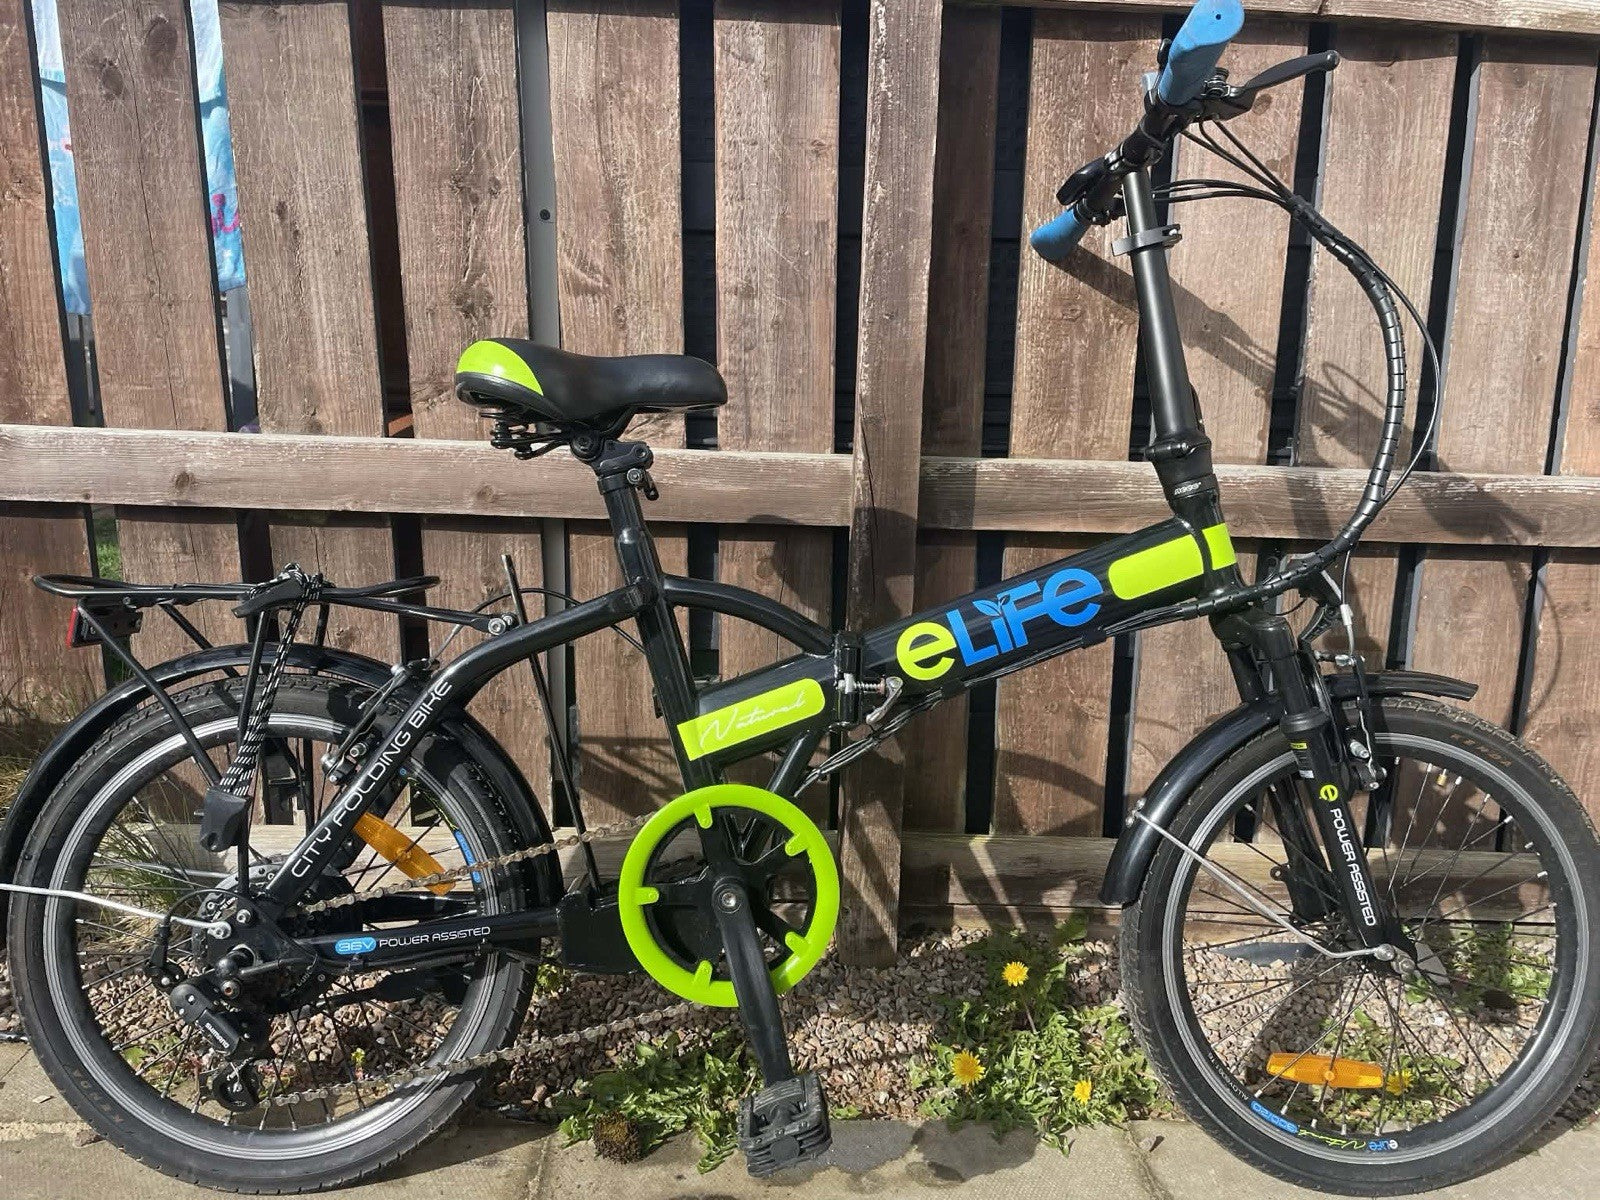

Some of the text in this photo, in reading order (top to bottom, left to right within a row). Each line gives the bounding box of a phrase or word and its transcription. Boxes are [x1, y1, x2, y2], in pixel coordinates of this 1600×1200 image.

[291, 826, 332, 878] CITY
[332, 731, 411, 827] FOLDING
[409, 681, 453, 729] BIKE
[1330, 807, 1377, 927] POWER ASSISTED
[337, 926, 491, 953] 36V POWER ASSISTED
[205, 1022, 230, 1049] SHIMANO
